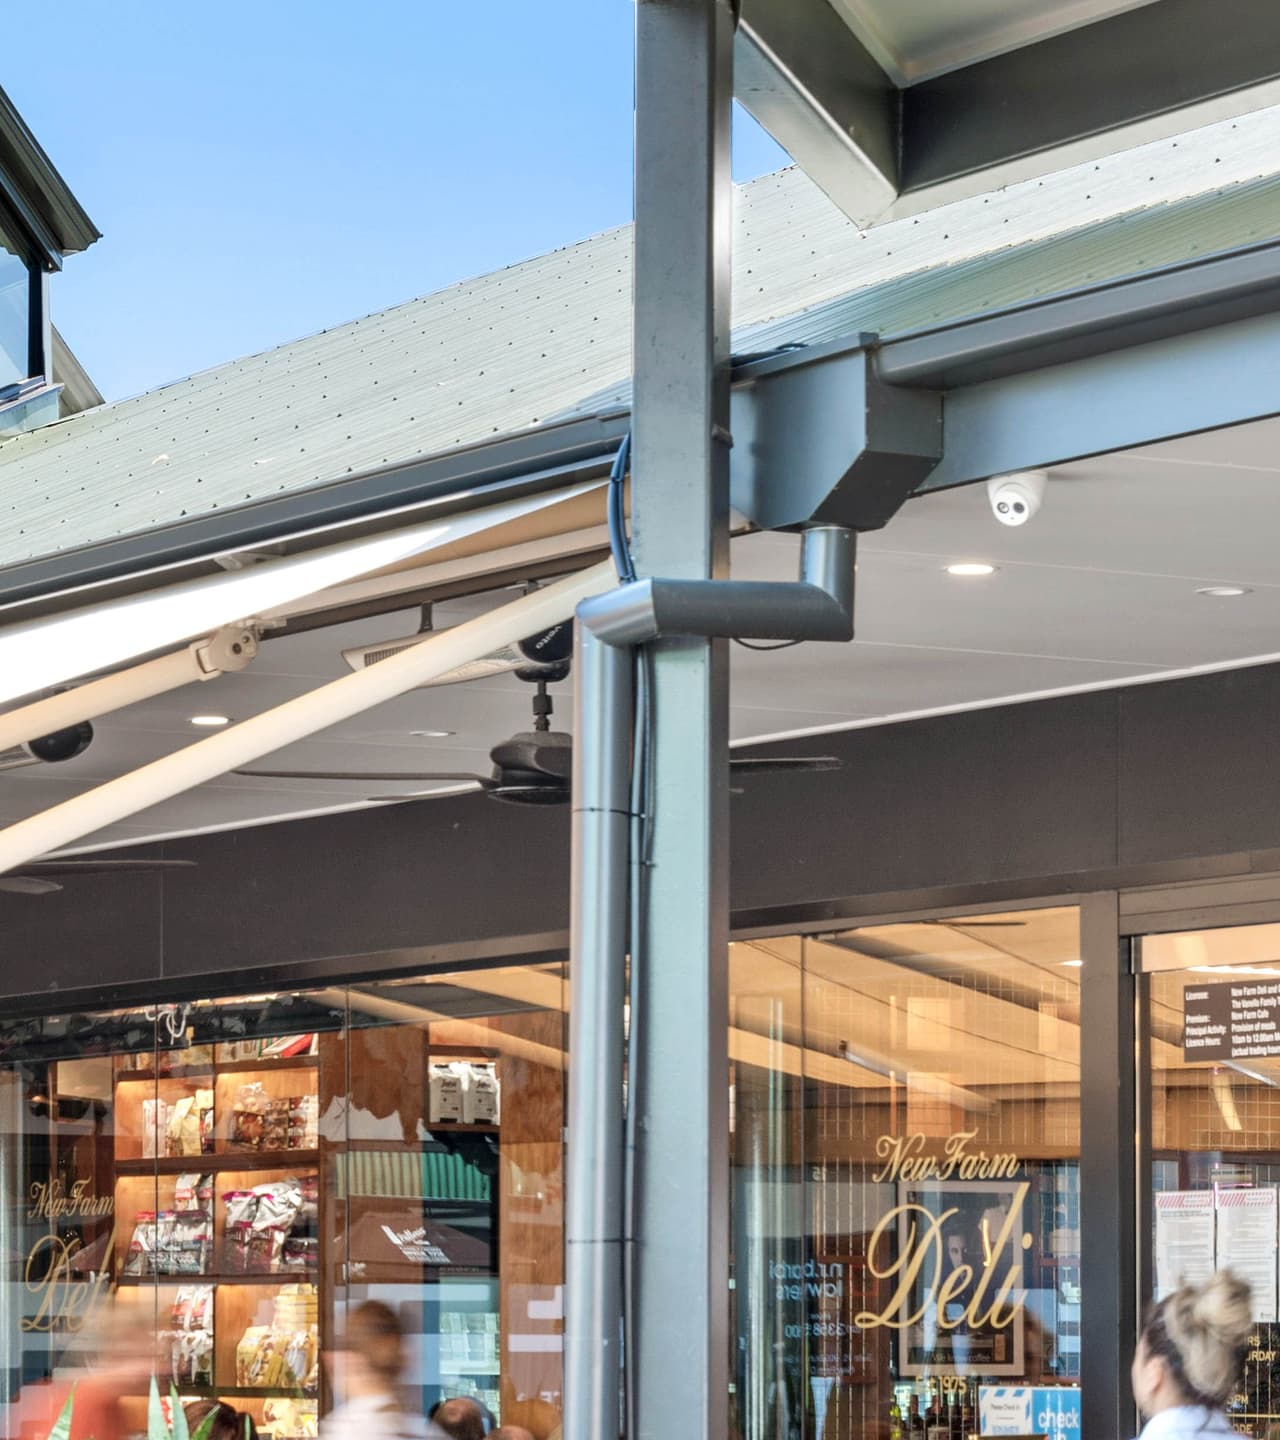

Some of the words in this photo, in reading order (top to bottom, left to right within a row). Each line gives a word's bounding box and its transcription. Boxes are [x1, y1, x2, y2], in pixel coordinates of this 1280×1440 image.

[1231, 987, 1243, 997] New
[1243, 986, 1257, 996] Farm
[872, 1132, 937, 1183] New
[935, 1127, 1021, 1181] Farm
[64, 1176, 114, 1217] Farm
[854, 1181, 1033, 1329] Deli
[938, 1375, 968, 1395] 1975
[1038, 1407, 1080, 1429] check
